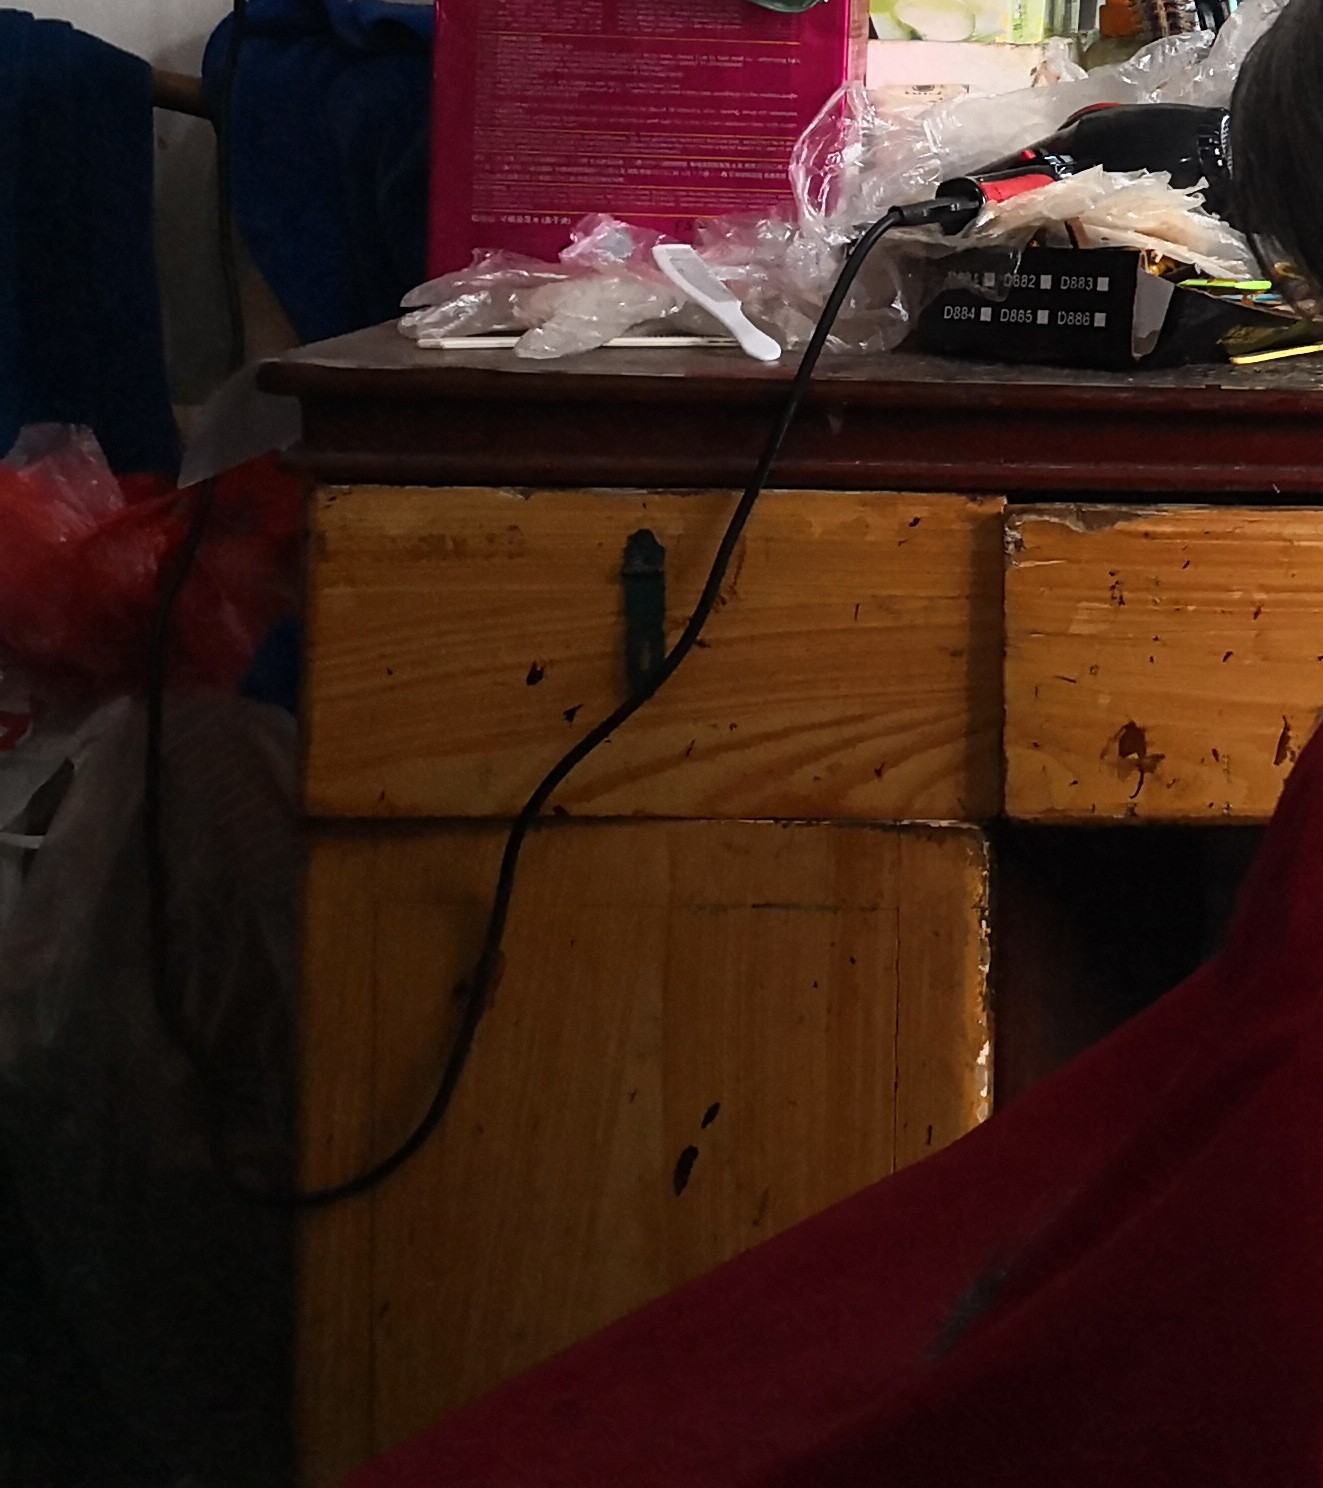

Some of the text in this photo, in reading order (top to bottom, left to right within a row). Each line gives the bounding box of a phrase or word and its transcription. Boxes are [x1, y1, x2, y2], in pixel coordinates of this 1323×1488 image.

[1003, 273, 1094, 291] D882 D883
[943, 305, 1091, 326] D884 D885 D886
